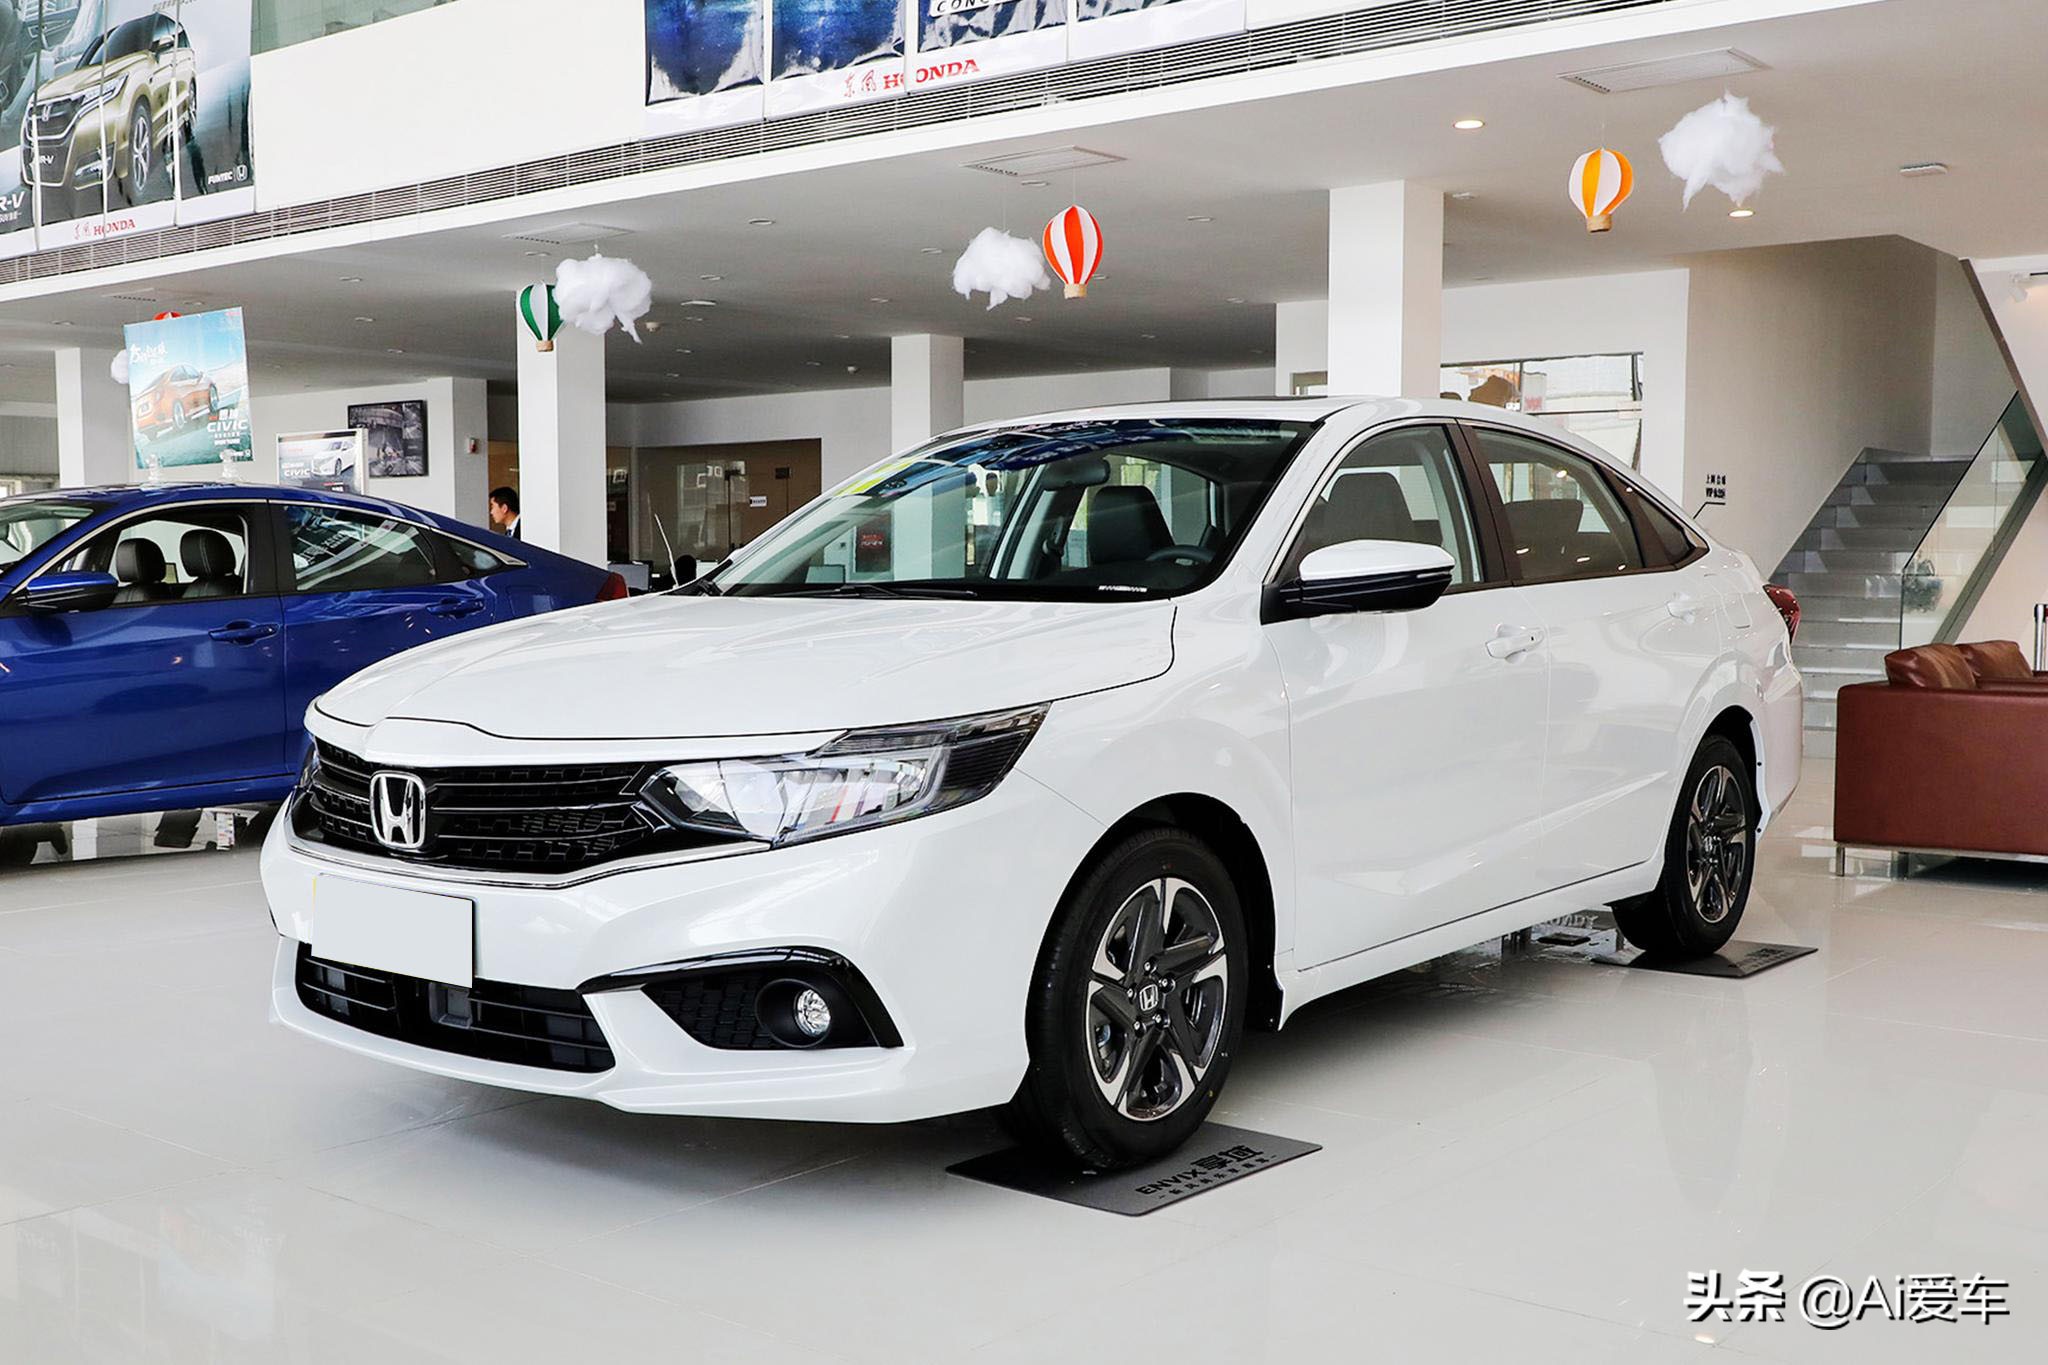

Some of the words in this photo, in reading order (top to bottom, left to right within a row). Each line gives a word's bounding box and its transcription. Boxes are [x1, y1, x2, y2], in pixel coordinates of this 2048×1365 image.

[883, 59, 979, 90] HONDA
[207, 420, 249, 432] CIVIC
[1136, 1168, 1206, 1194] ENVIX
